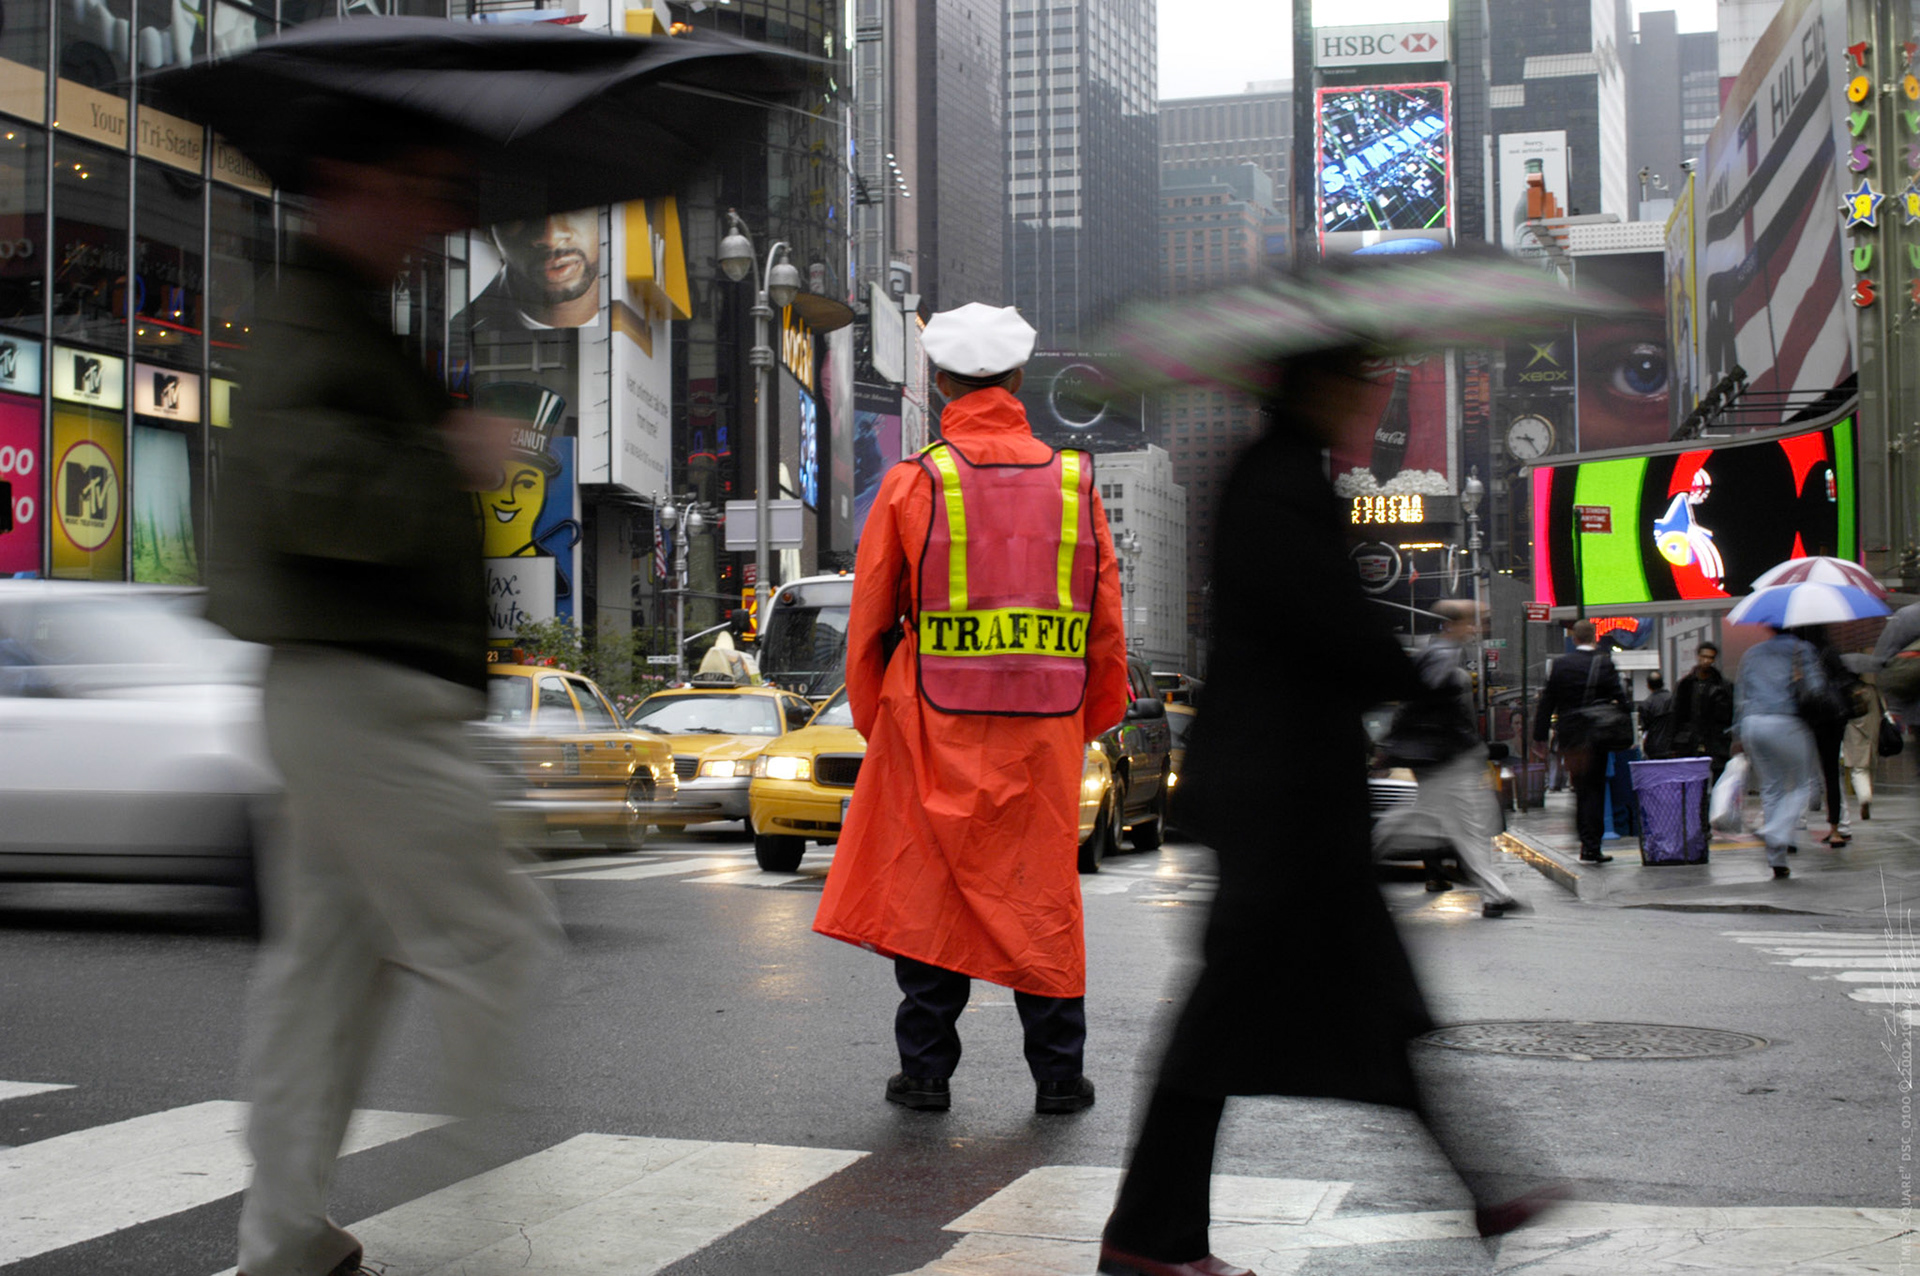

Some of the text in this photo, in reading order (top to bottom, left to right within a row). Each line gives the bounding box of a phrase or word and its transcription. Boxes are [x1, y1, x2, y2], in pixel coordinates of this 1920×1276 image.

[1323, 34, 1395, 57] HSBC
[91, 102, 125, 136] Your
[1321, 115, 1446, 194] SAMSUNG
[74, 354, 104, 394] MTV
[153, 372, 183, 410] MTV
[1519, 370, 1568, 383] XBOX
[66, 461, 113, 520] MTV
[928, 613, 1083, 652] TRAFFIC
